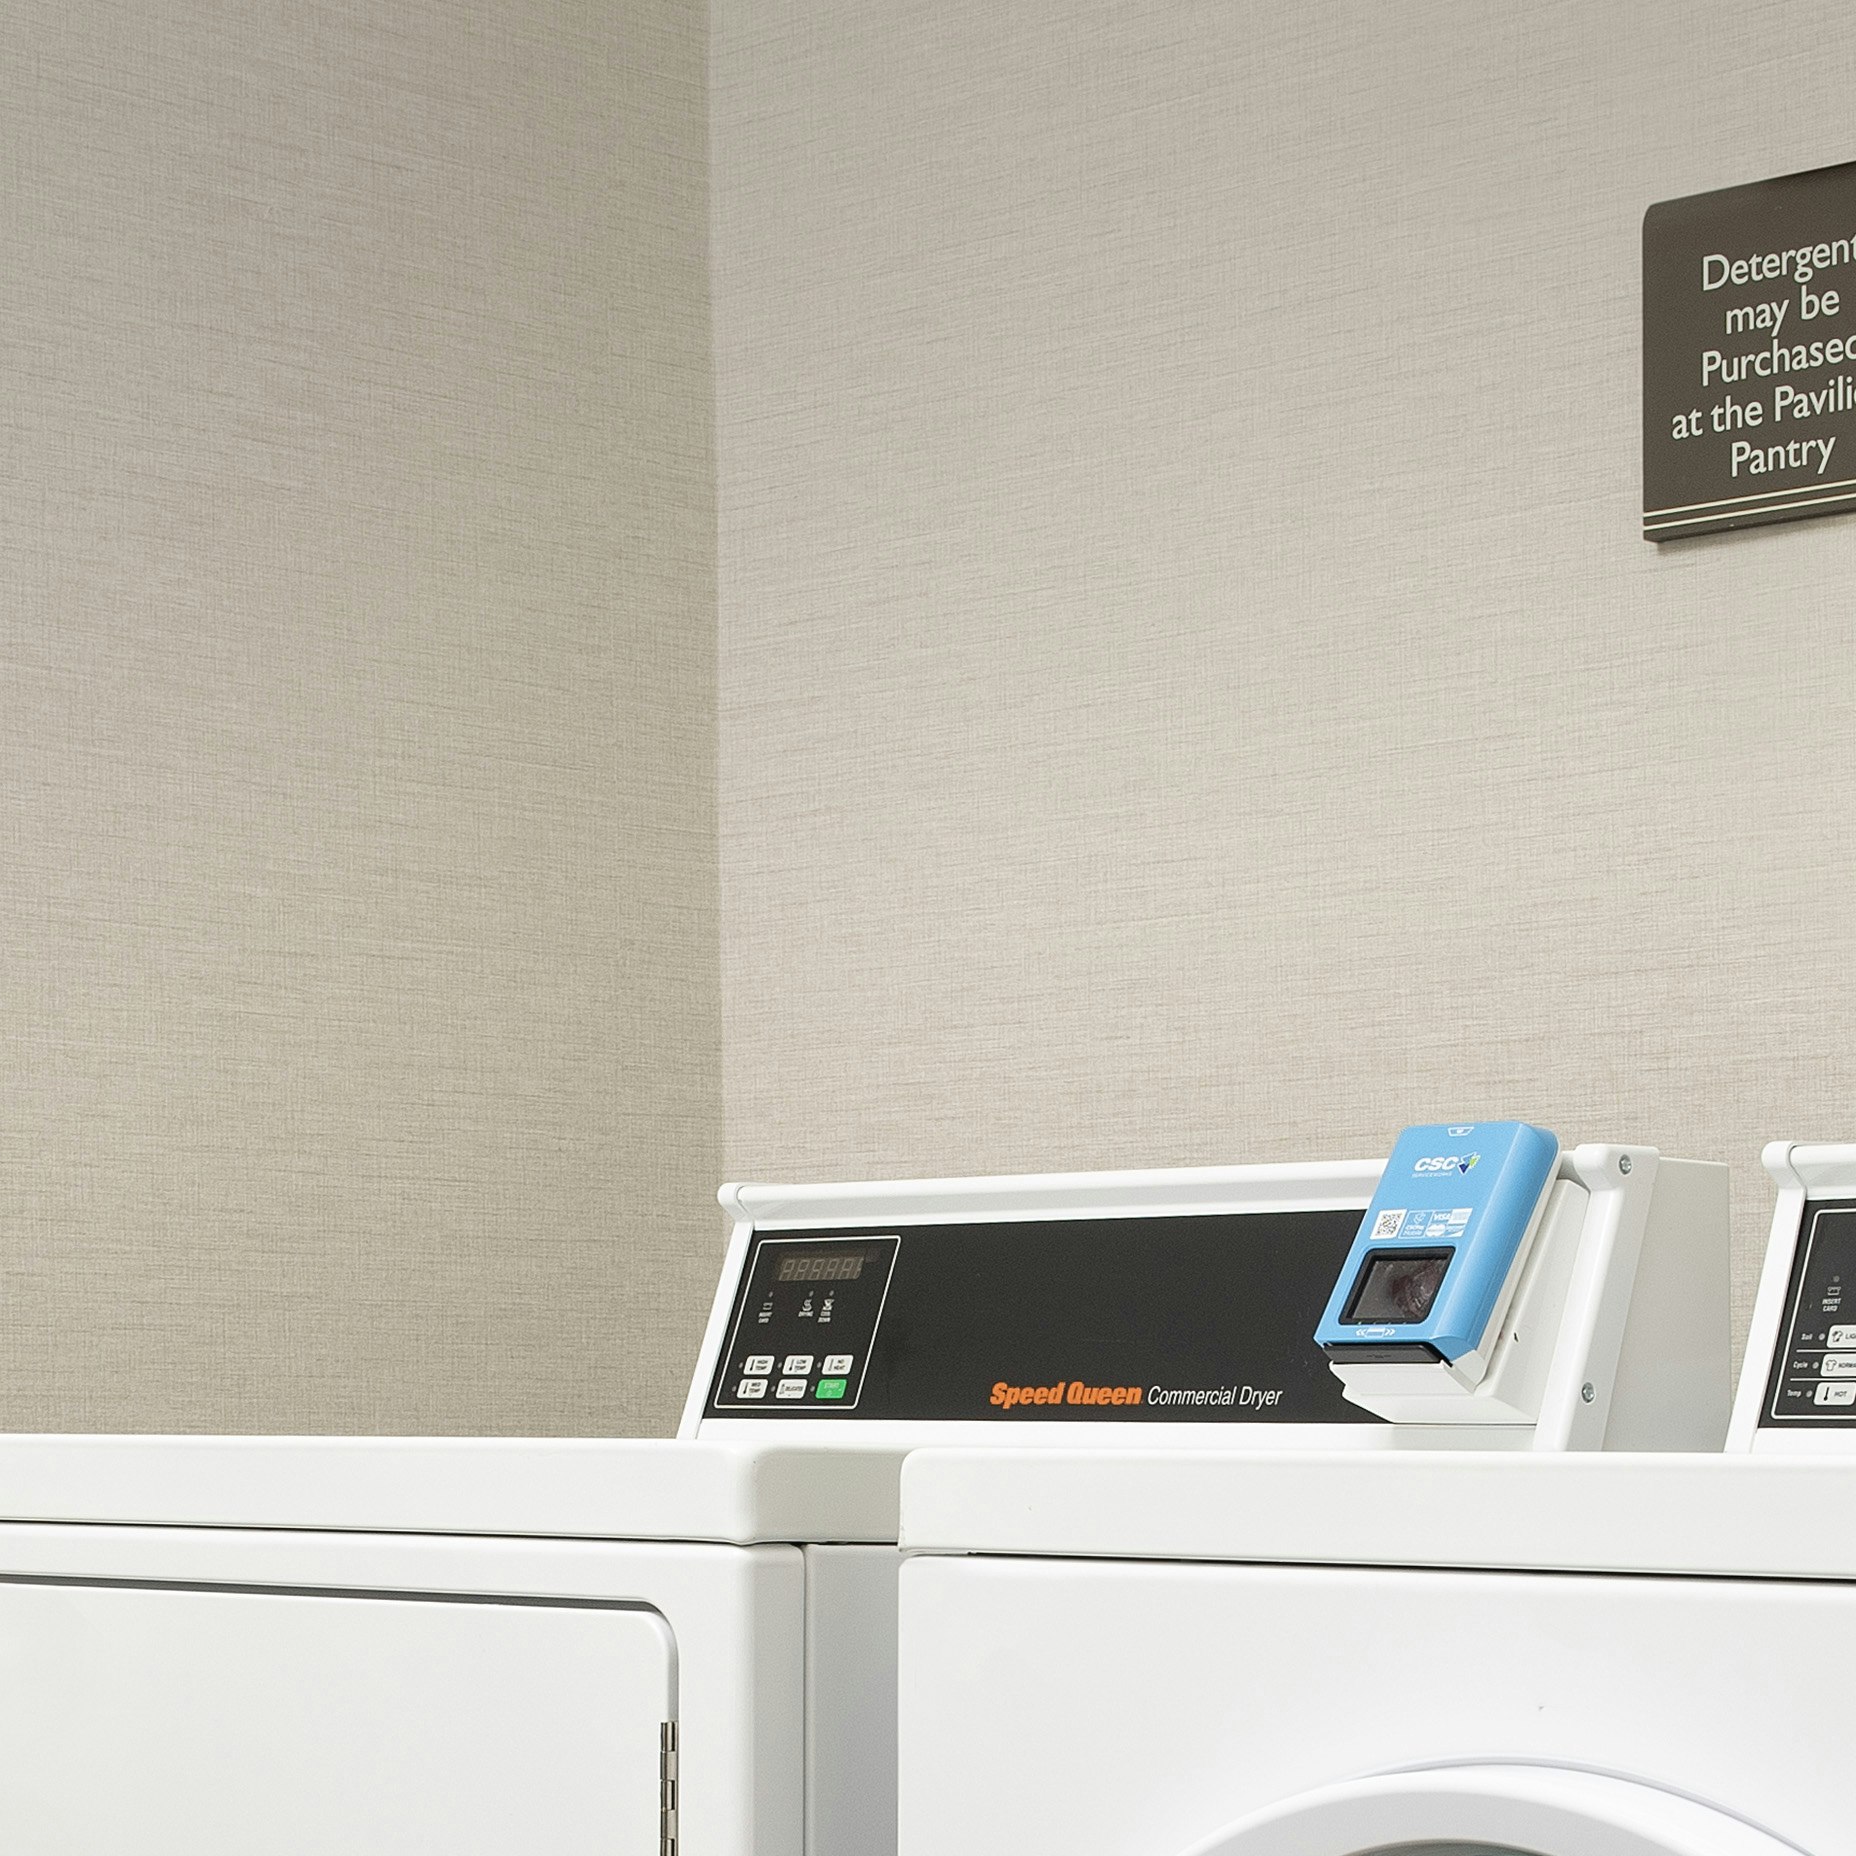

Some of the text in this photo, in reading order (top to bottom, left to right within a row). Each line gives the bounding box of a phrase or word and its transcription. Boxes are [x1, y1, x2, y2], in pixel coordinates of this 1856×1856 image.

[1726, 284, 1840, 337] may be
[1672, 408, 1703, 440] at
[1710, 395, 1763, 433] the
[1731, 436, 1836, 478] Pantry
[1414, 1156, 1459, 1172] CSC
[989, 1380, 1284, 1411] Speed Queen Commercial Dryer
